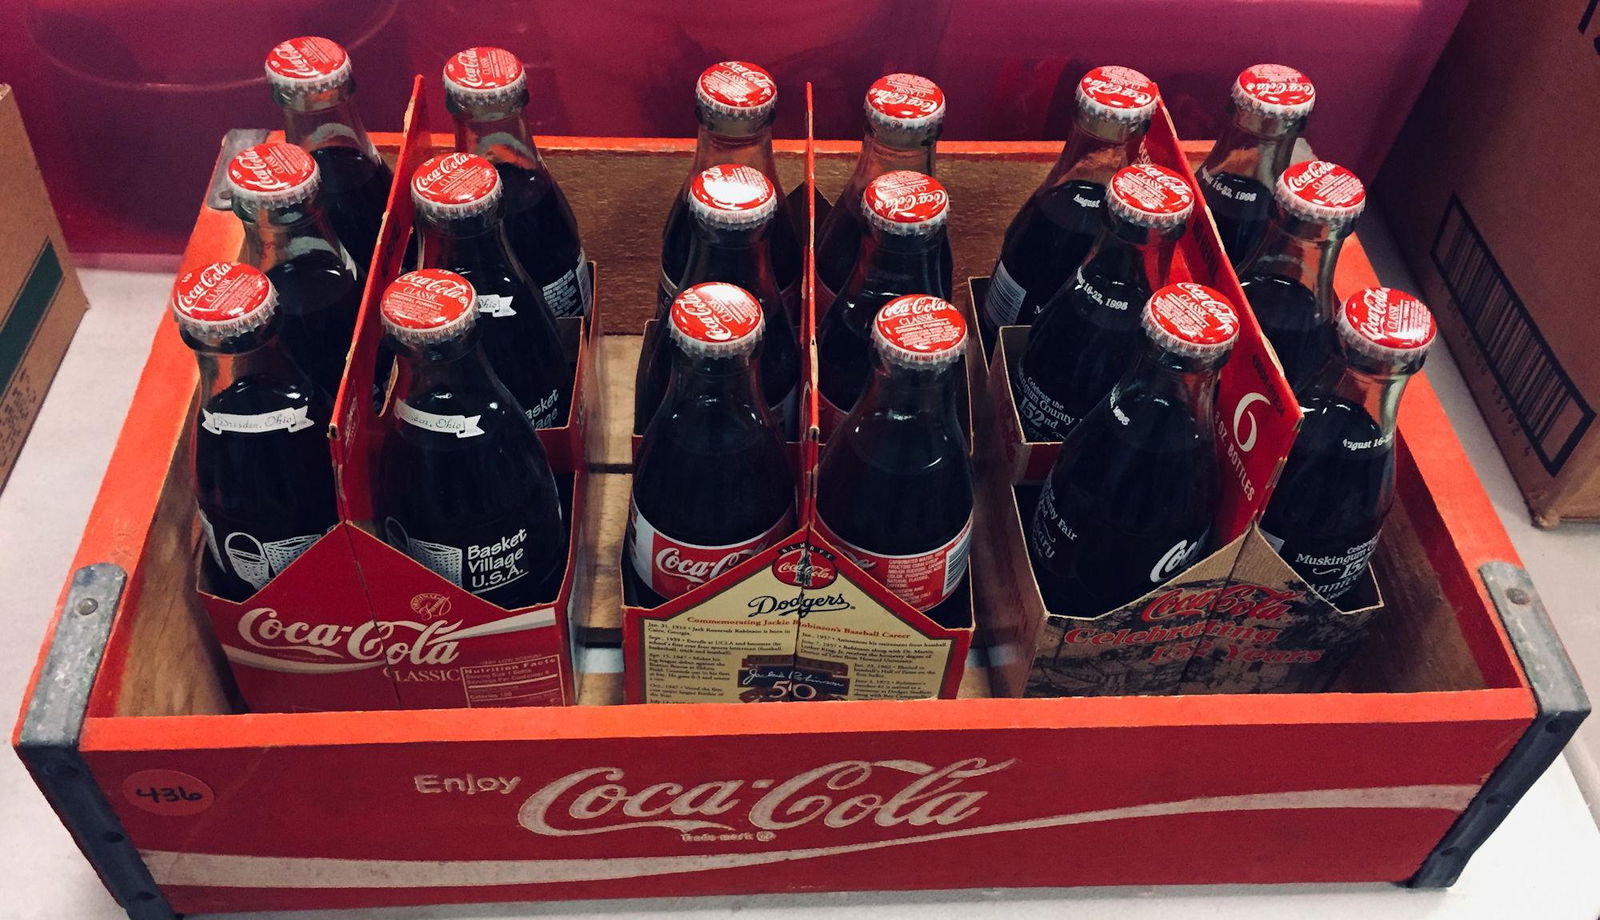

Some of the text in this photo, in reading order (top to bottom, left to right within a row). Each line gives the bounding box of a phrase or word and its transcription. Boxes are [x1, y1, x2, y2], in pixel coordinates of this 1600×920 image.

[415, 152, 470, 194] Coca-Cola
[886, 188, 946, 219] Coca-Cola
[1073, 193, 1101, 208] August
[177, 262, 233, 314] Coca-Cola
[395, 271, 468, 300] Coca-Cola
[402, 286, 438, 302] CLASSIC
[878, 296, 947, 322] Coca-Cola
[1105, 298, 1129, 311] 1998
[1176, 282, 1239, 324] Coca-Cola
[1360, 287, 1388, 340] Coca-Cola
[898, 312, 937, 325] CLASSIC
[1040, 400, 1075, 426] County
[1233, 392, 1271, 453] 6
[1227, 442, 1255, 502] BOTTLES
[1057, 518, 1078, 541] Fair
[467, 528, 528, 561] Basket
[1295, 545, 1367, 568] Muskingum
[467, 547, 525, 575] Village
[471, 563, 525, 588] U.S.A.
[747, 593, 850, 619] Dodgers
[1140, 584, 1304, 622] Coca-Cola
[237, 607, 464, 667] Coca-Cola
[687, 617, 761, 627] Commemorating
[763, 619, 790, 627] Jackie
[844, 628, 880, 637] Baseball
[882, 632, 910, 640] Career
[1063, 620, 1282, 646] Celebrating
[464, 664, 520, 675] Nutrition
[523, 657, 557, 668] Facts
[1149, 641, 1327, 665] 152 Years
[383, 667, 461, 688] CLASSIC
[769, 679, 818, 700] 50
[135, 785, 204, 804] 436
[414, 773, 522, 795] Enjoy
[516, 757, 1017, 837] Coca-Cola
